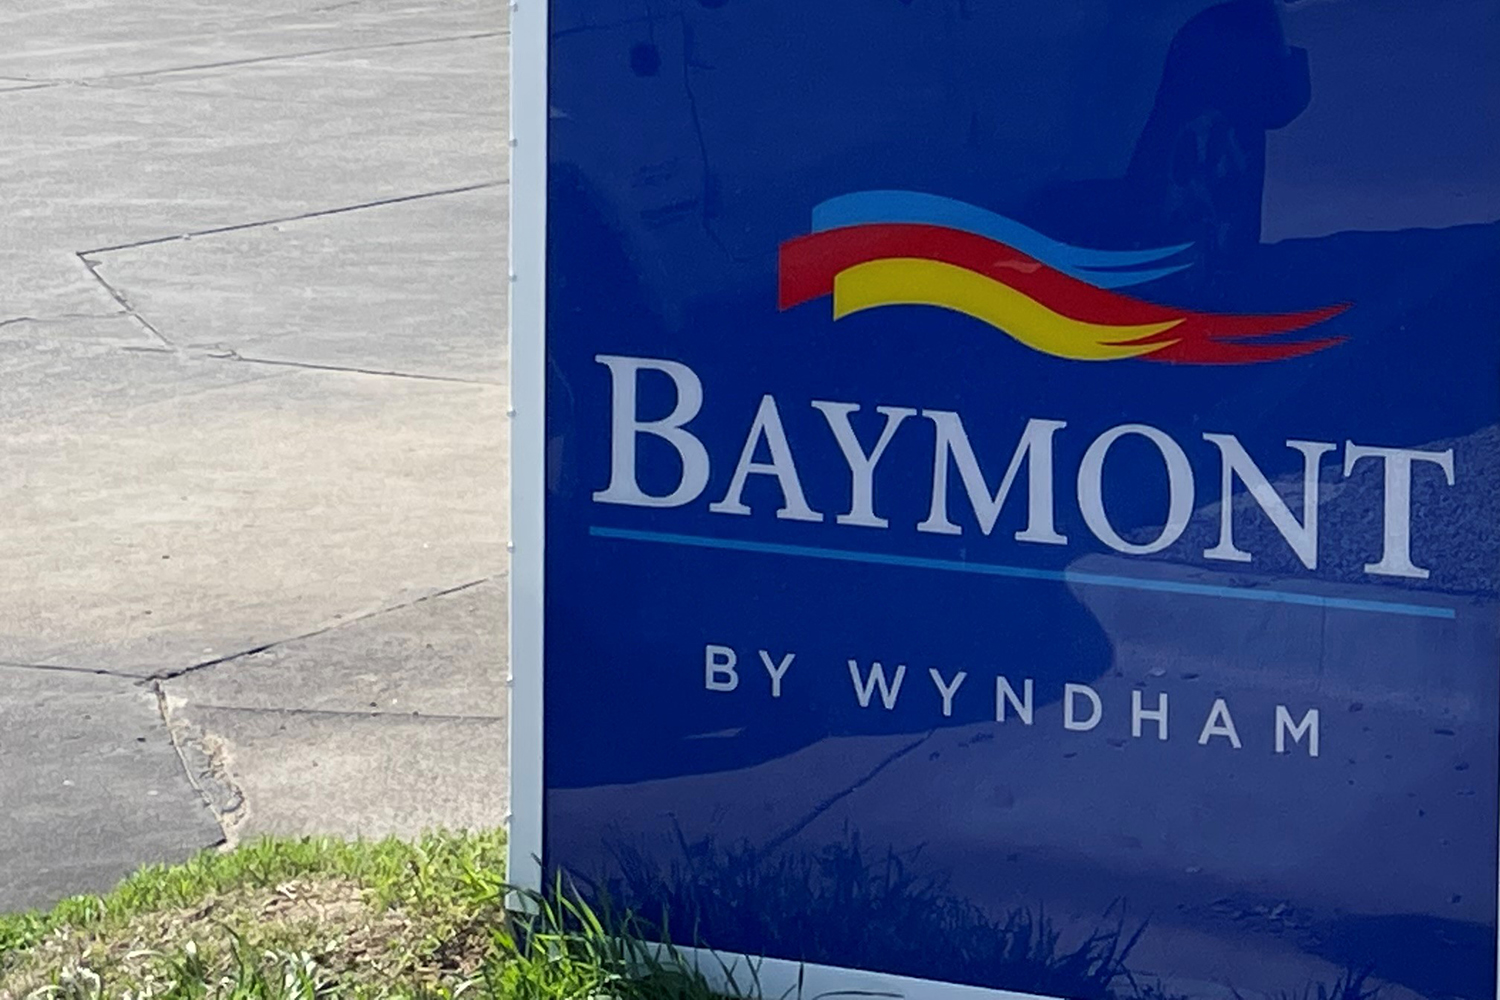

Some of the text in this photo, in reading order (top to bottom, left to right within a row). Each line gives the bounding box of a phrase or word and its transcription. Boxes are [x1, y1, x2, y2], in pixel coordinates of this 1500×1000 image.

[593, 355, 1455, 579] BAYMONT
[704, 645, 1321, 757] BY WYNDHAM
